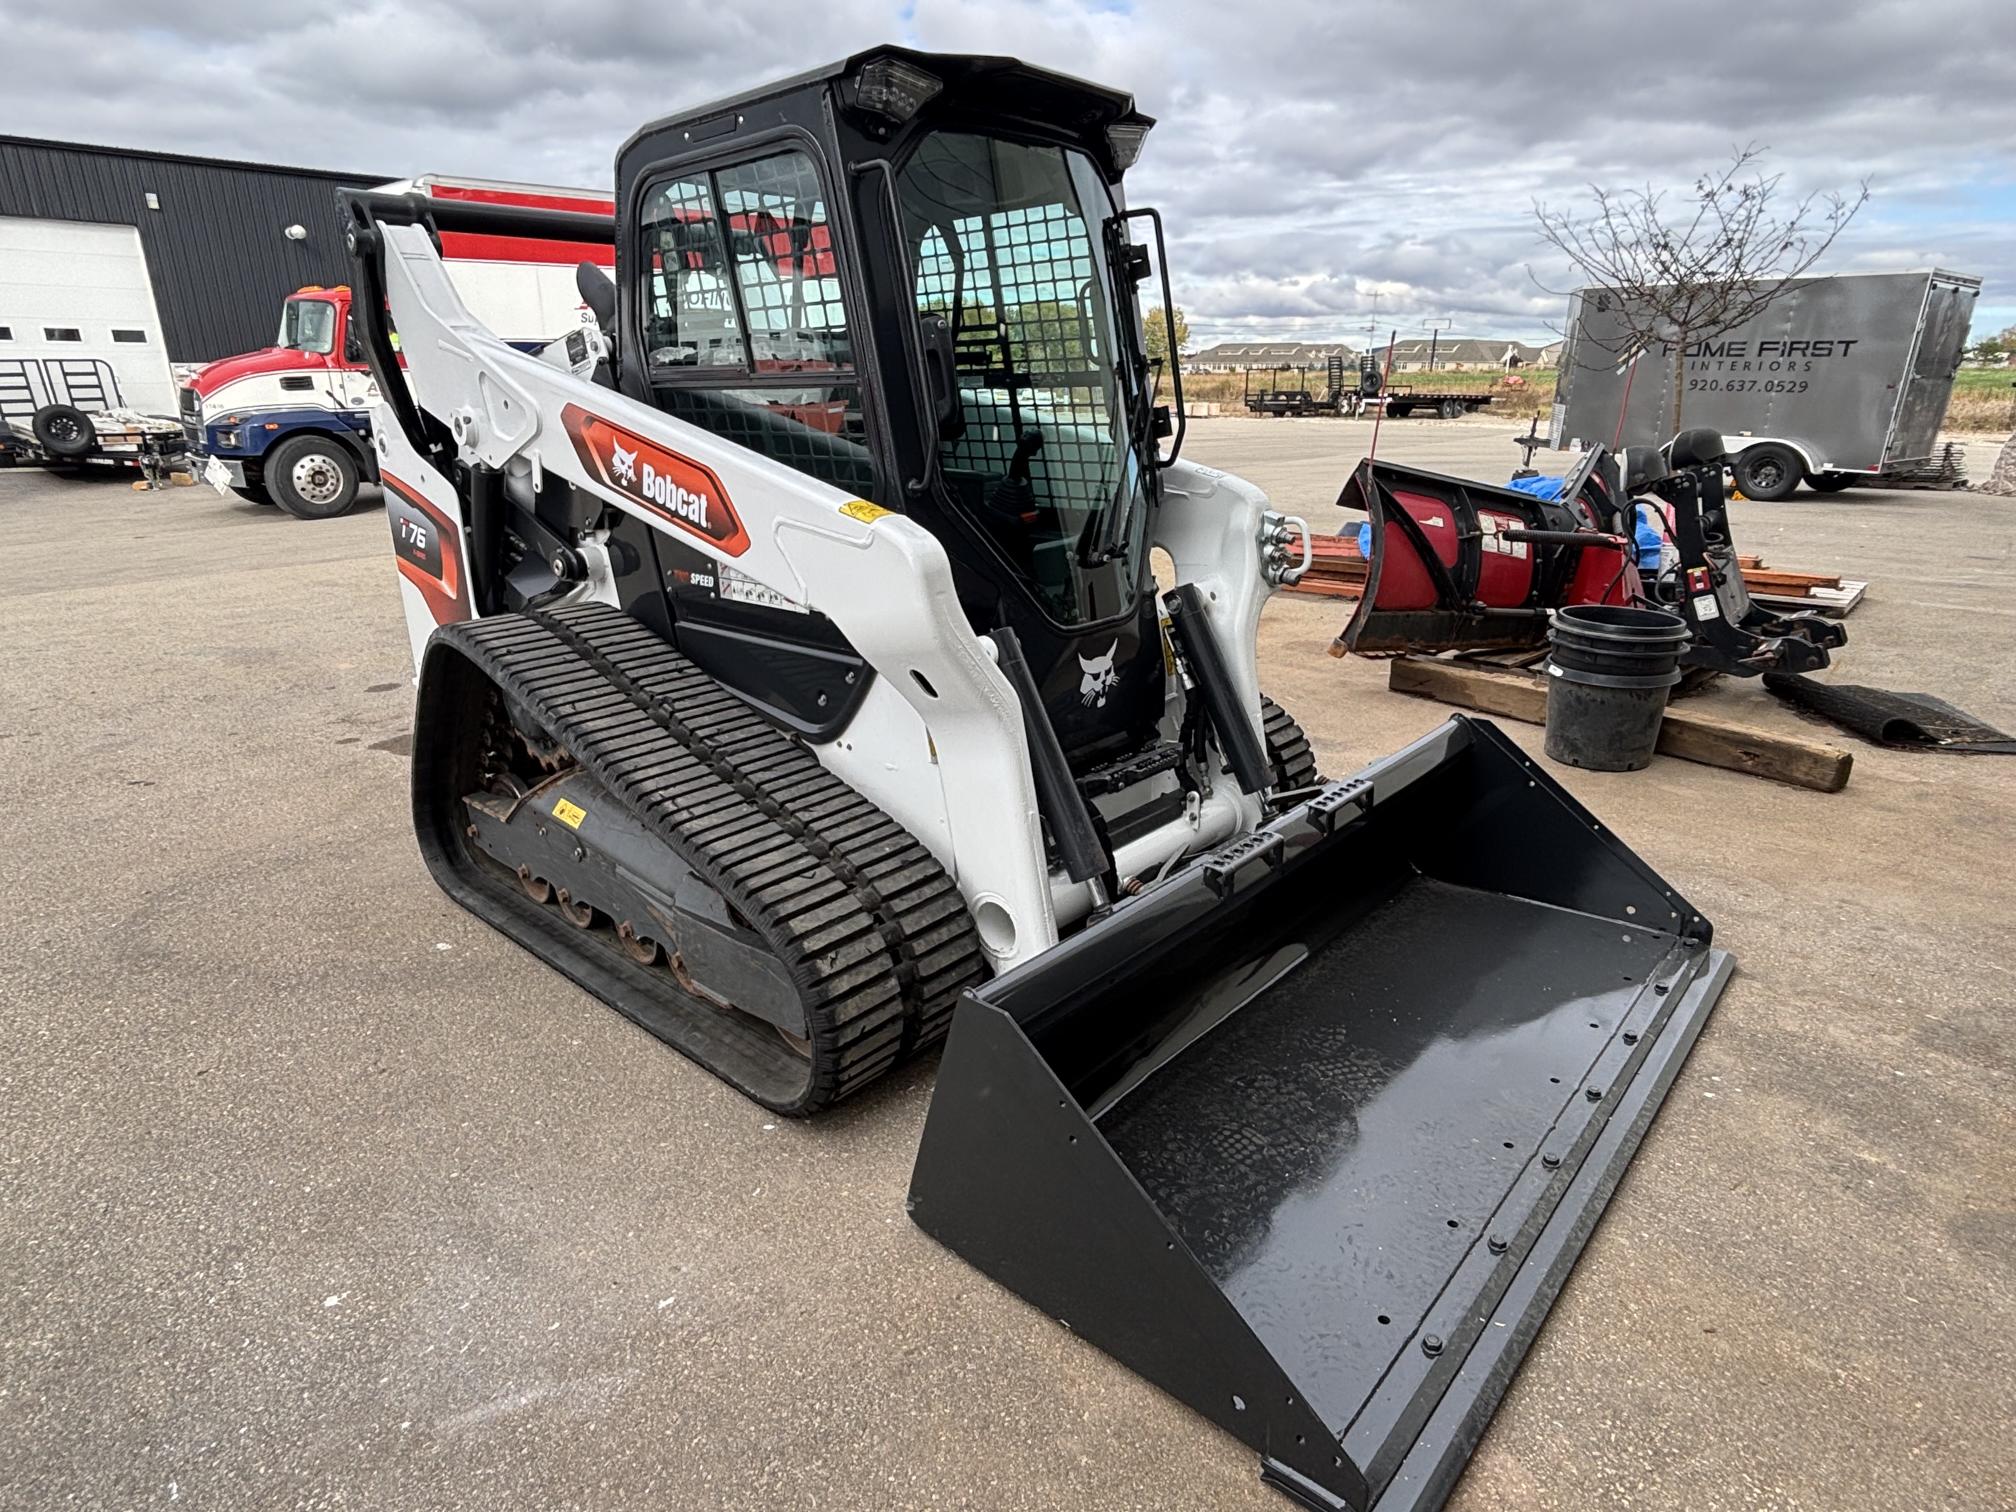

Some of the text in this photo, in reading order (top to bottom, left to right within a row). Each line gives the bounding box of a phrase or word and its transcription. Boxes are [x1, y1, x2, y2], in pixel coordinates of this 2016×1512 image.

[1757, 340, 1858, 357] FIRST
[1690, 360, 1813, 372] INTERIORS
[1688, 379, 1809, 393] 920.637.0529
[642, 462, 708, 528] Bobcat
[690, 572, 714, 588] SPEED
